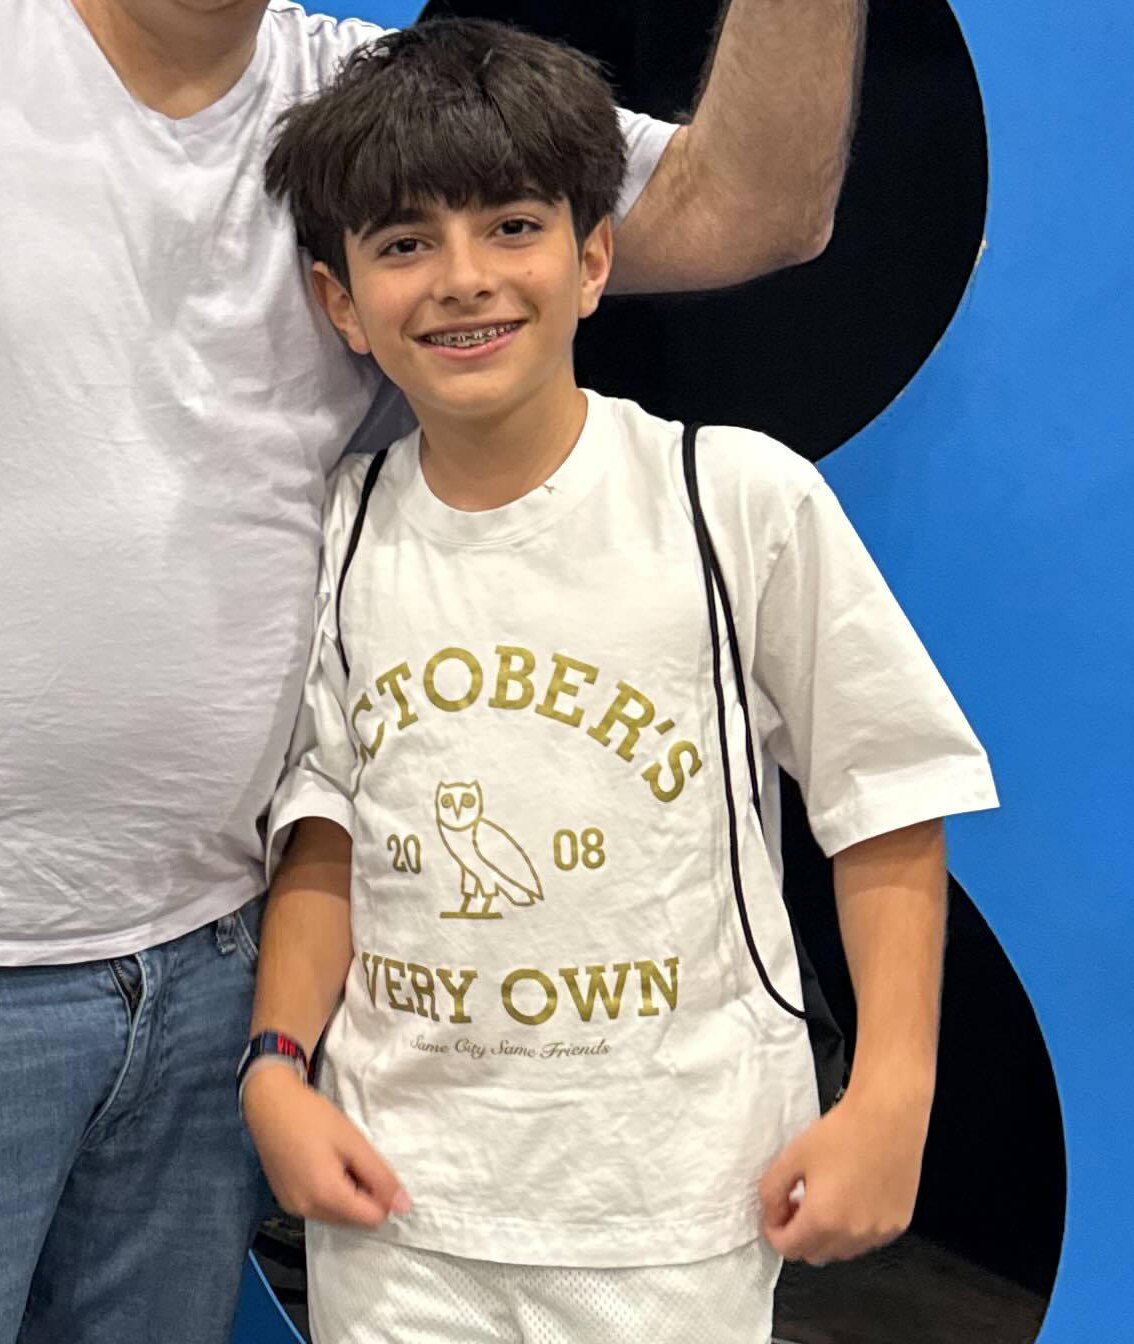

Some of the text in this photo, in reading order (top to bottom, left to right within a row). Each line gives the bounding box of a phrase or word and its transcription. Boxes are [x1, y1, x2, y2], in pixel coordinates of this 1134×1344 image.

[351, 644, 704, 805] CTOBER'S
[386, 826, 607, 875] 20 08
[361, 950, 681, 1026] VERY OWN
[410, 1034, 613, 1060] Same City Same Friends
